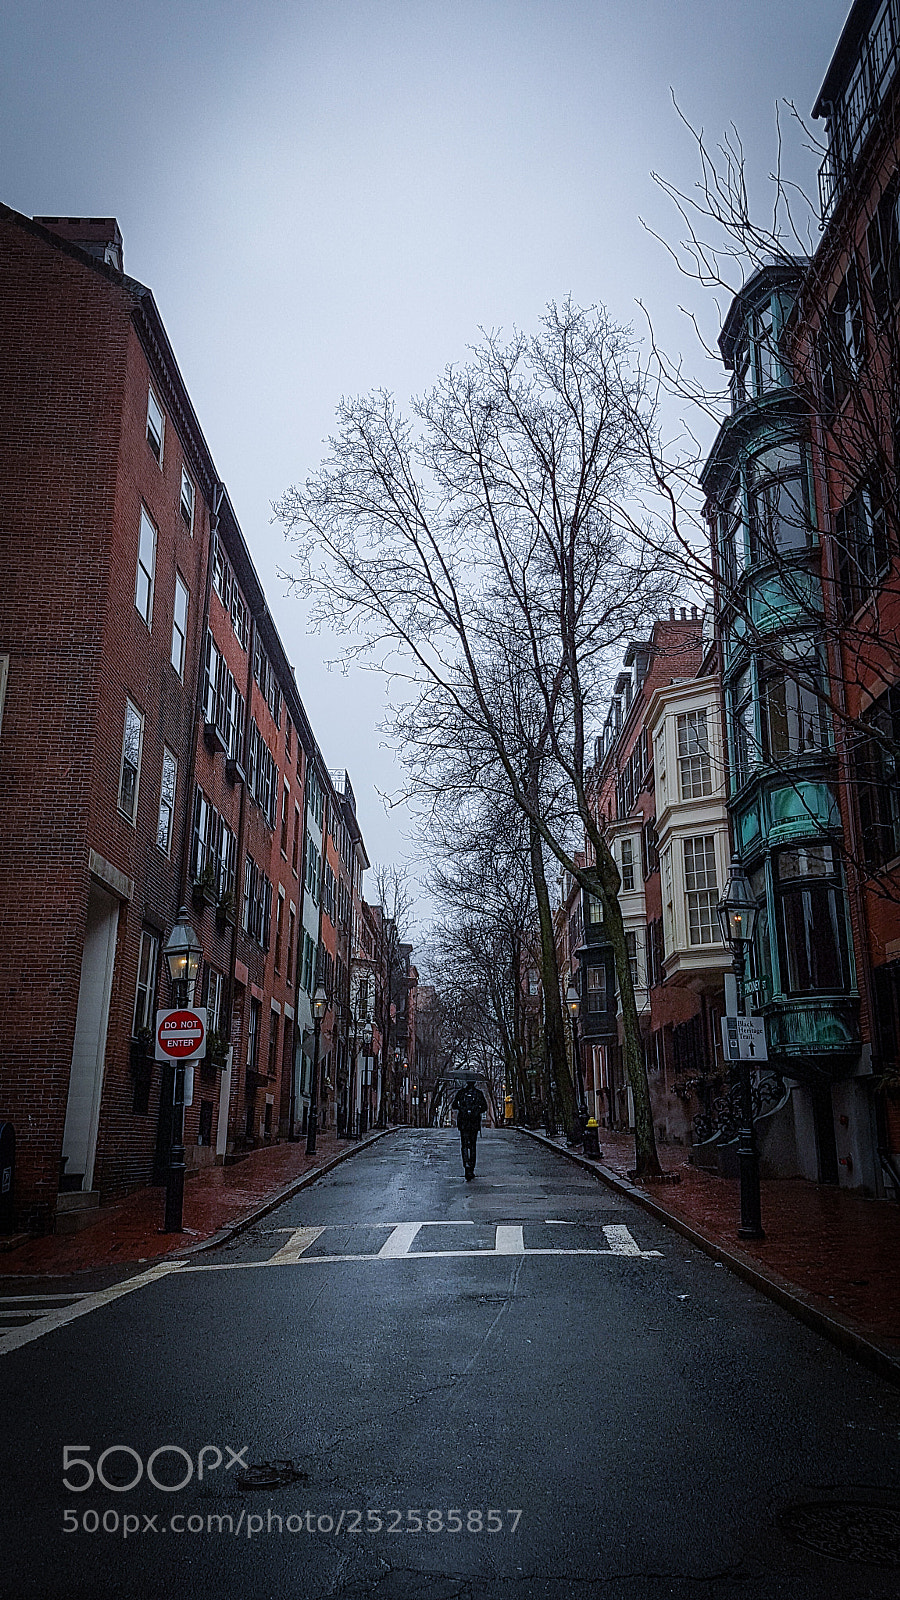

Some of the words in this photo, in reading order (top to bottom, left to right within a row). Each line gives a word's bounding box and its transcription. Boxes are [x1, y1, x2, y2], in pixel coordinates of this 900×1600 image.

[164, 1021, 177, 1029] DO
[180, 1020, 198, 1028] NOT
[167, 1039, 194, 1047] ENTER
